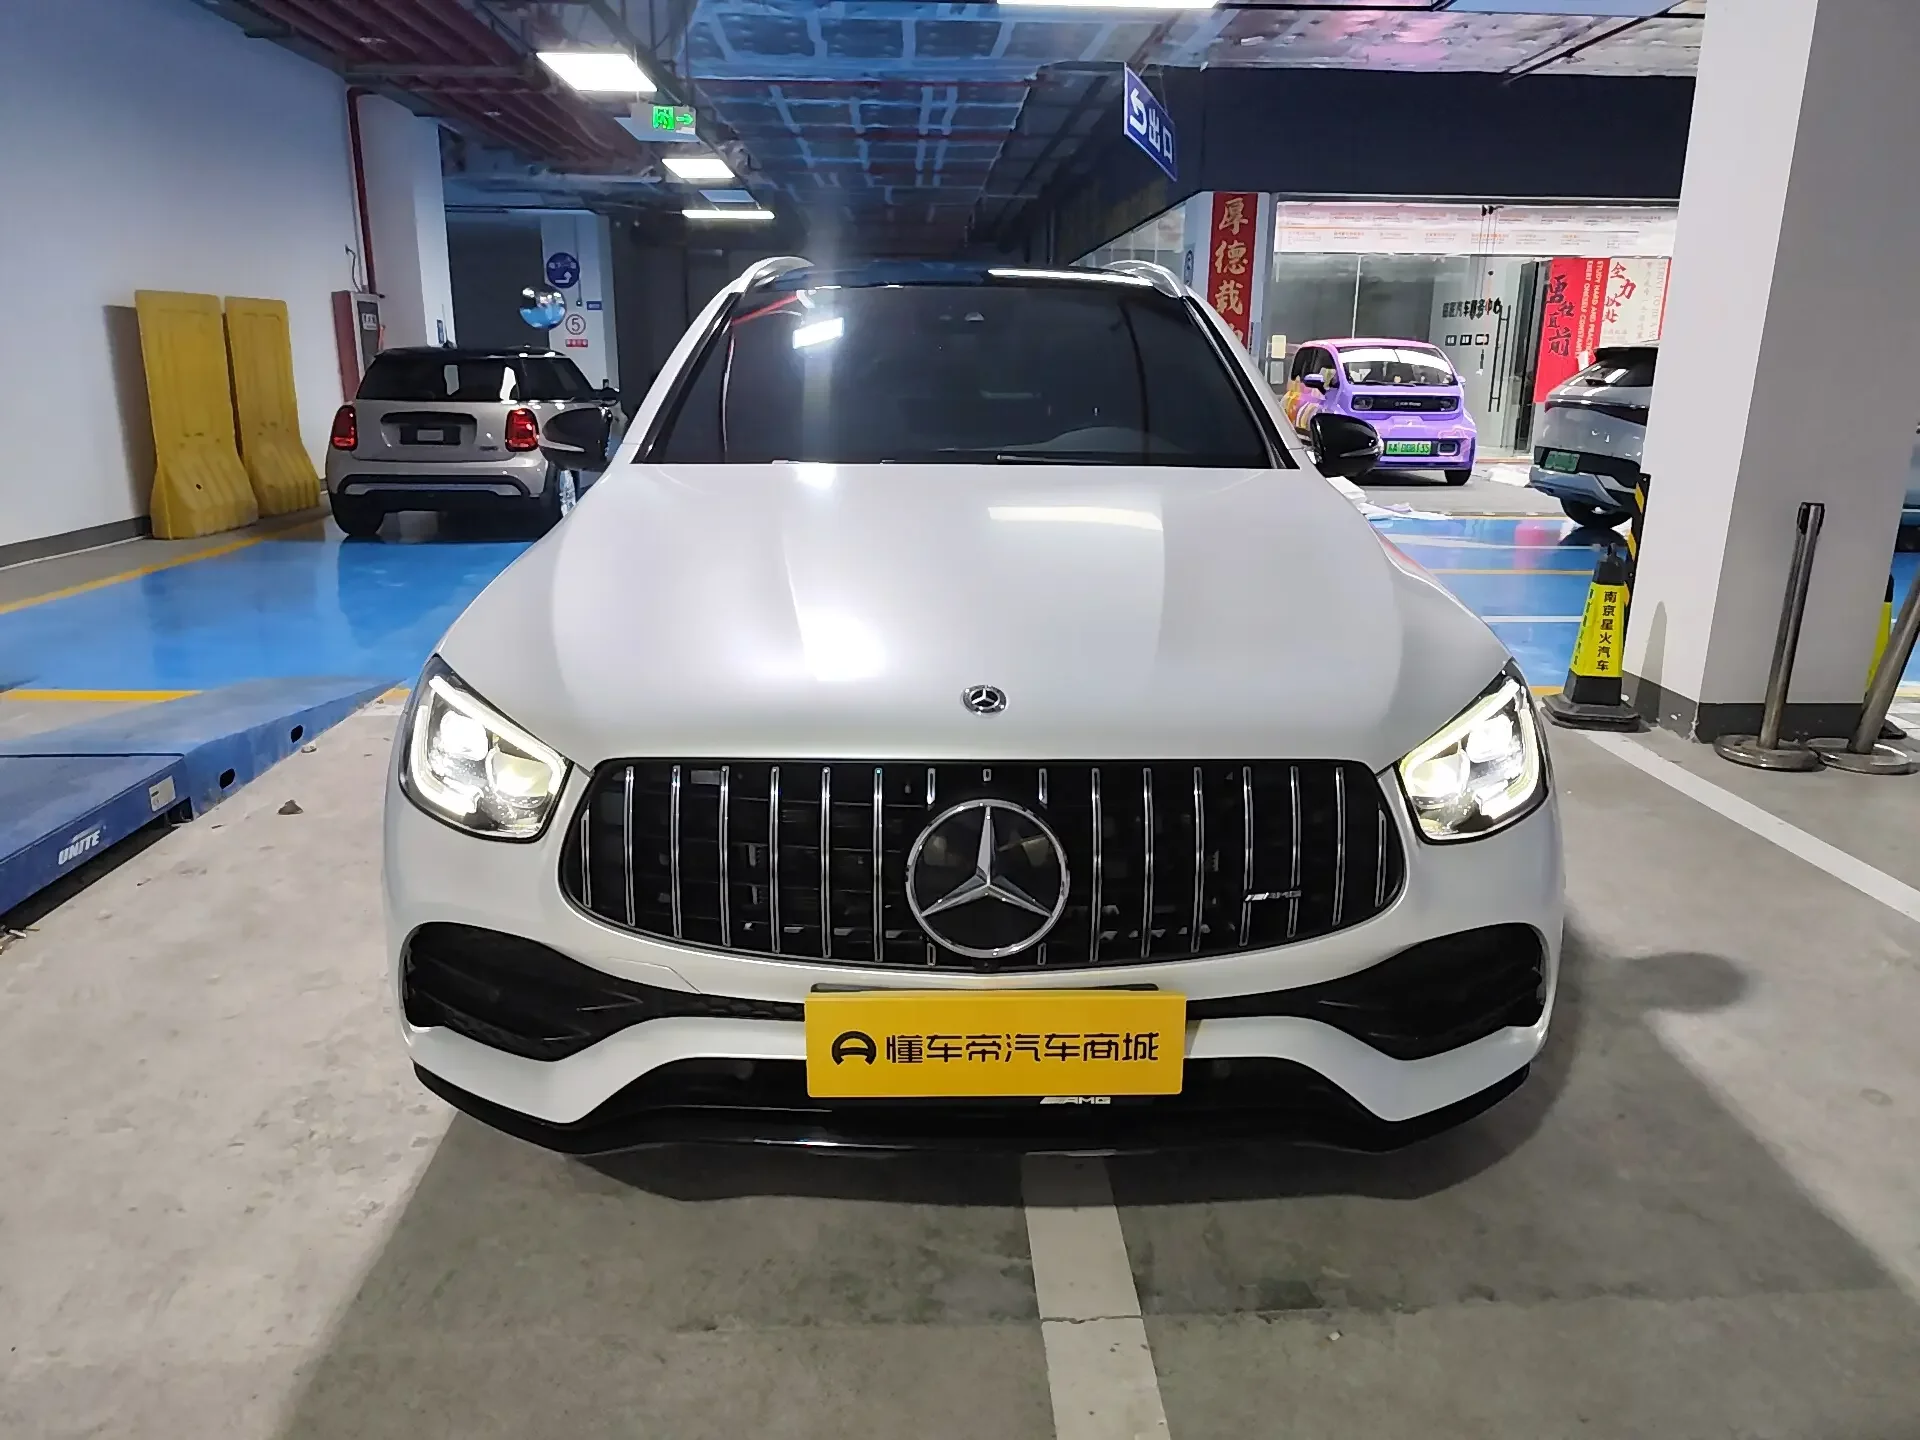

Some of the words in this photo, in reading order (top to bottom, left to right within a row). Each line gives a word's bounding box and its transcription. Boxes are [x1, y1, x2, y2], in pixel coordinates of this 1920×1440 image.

[1148, 107, 1173, 164] 出口
[1596, 590, 1618, 672] 南京星火汽车
[58, 829, 101, 866] UNITE
[885, 1031, 1161, 1064] 懂车帝汽车商城
[1062, 1096, 1112, 1105] AMG
